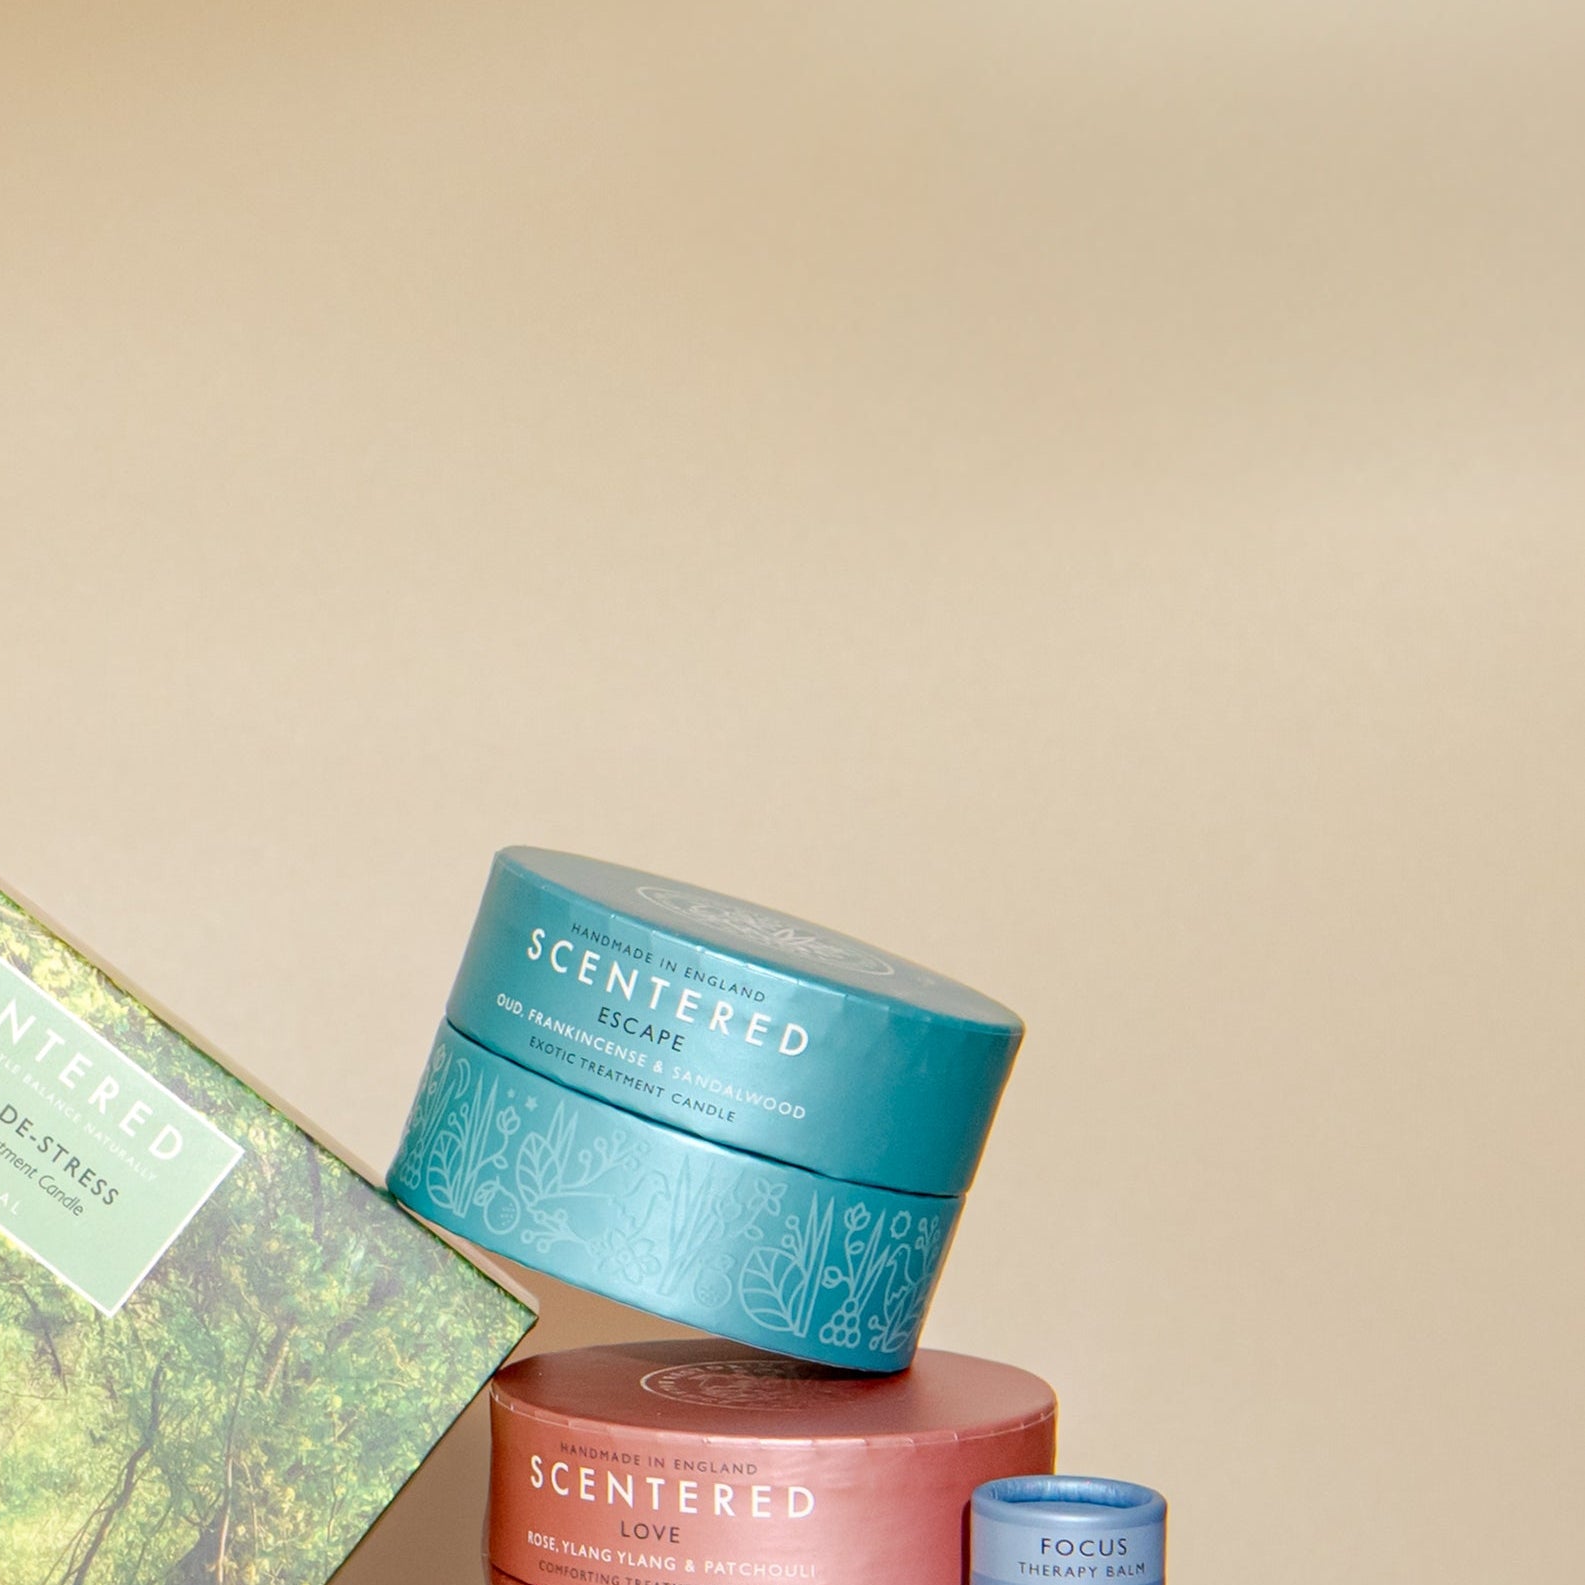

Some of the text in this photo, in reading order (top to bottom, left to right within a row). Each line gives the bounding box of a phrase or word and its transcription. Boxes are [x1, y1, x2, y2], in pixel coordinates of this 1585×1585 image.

[570, 922, 767, 1005] HANDMADE IN ENGLAND
[526, 927, 811, 1058] SCENTERED
[596, 1005, 686, 1054] ESCAPE
[527, 1008, 807, 1121] FRANKINCENSE & SANDALWOOD
[528, 1035, 737, 1124] EXOTIC TREATMENT CANDLE
[21, 1073, 84, 1128] BALANCE
[83, 1120, 158, 1182] NATURALLY
[38, 1173, 85, 1217] Candle
[559, 1441, 759, 1477] HANDMADE IN ENGLAND
[529, 1453, 817, 1520] SCENTERED
[526, 1529, 817, 1580] ROSE, YLANG YLANG & PATCHOULI
[619, 1519, 682, 1545] LOVE
[1040, 1537, 1129, 1557] FOCUS
[1017, 1560, 1147, 1579] THERAPY BALM
